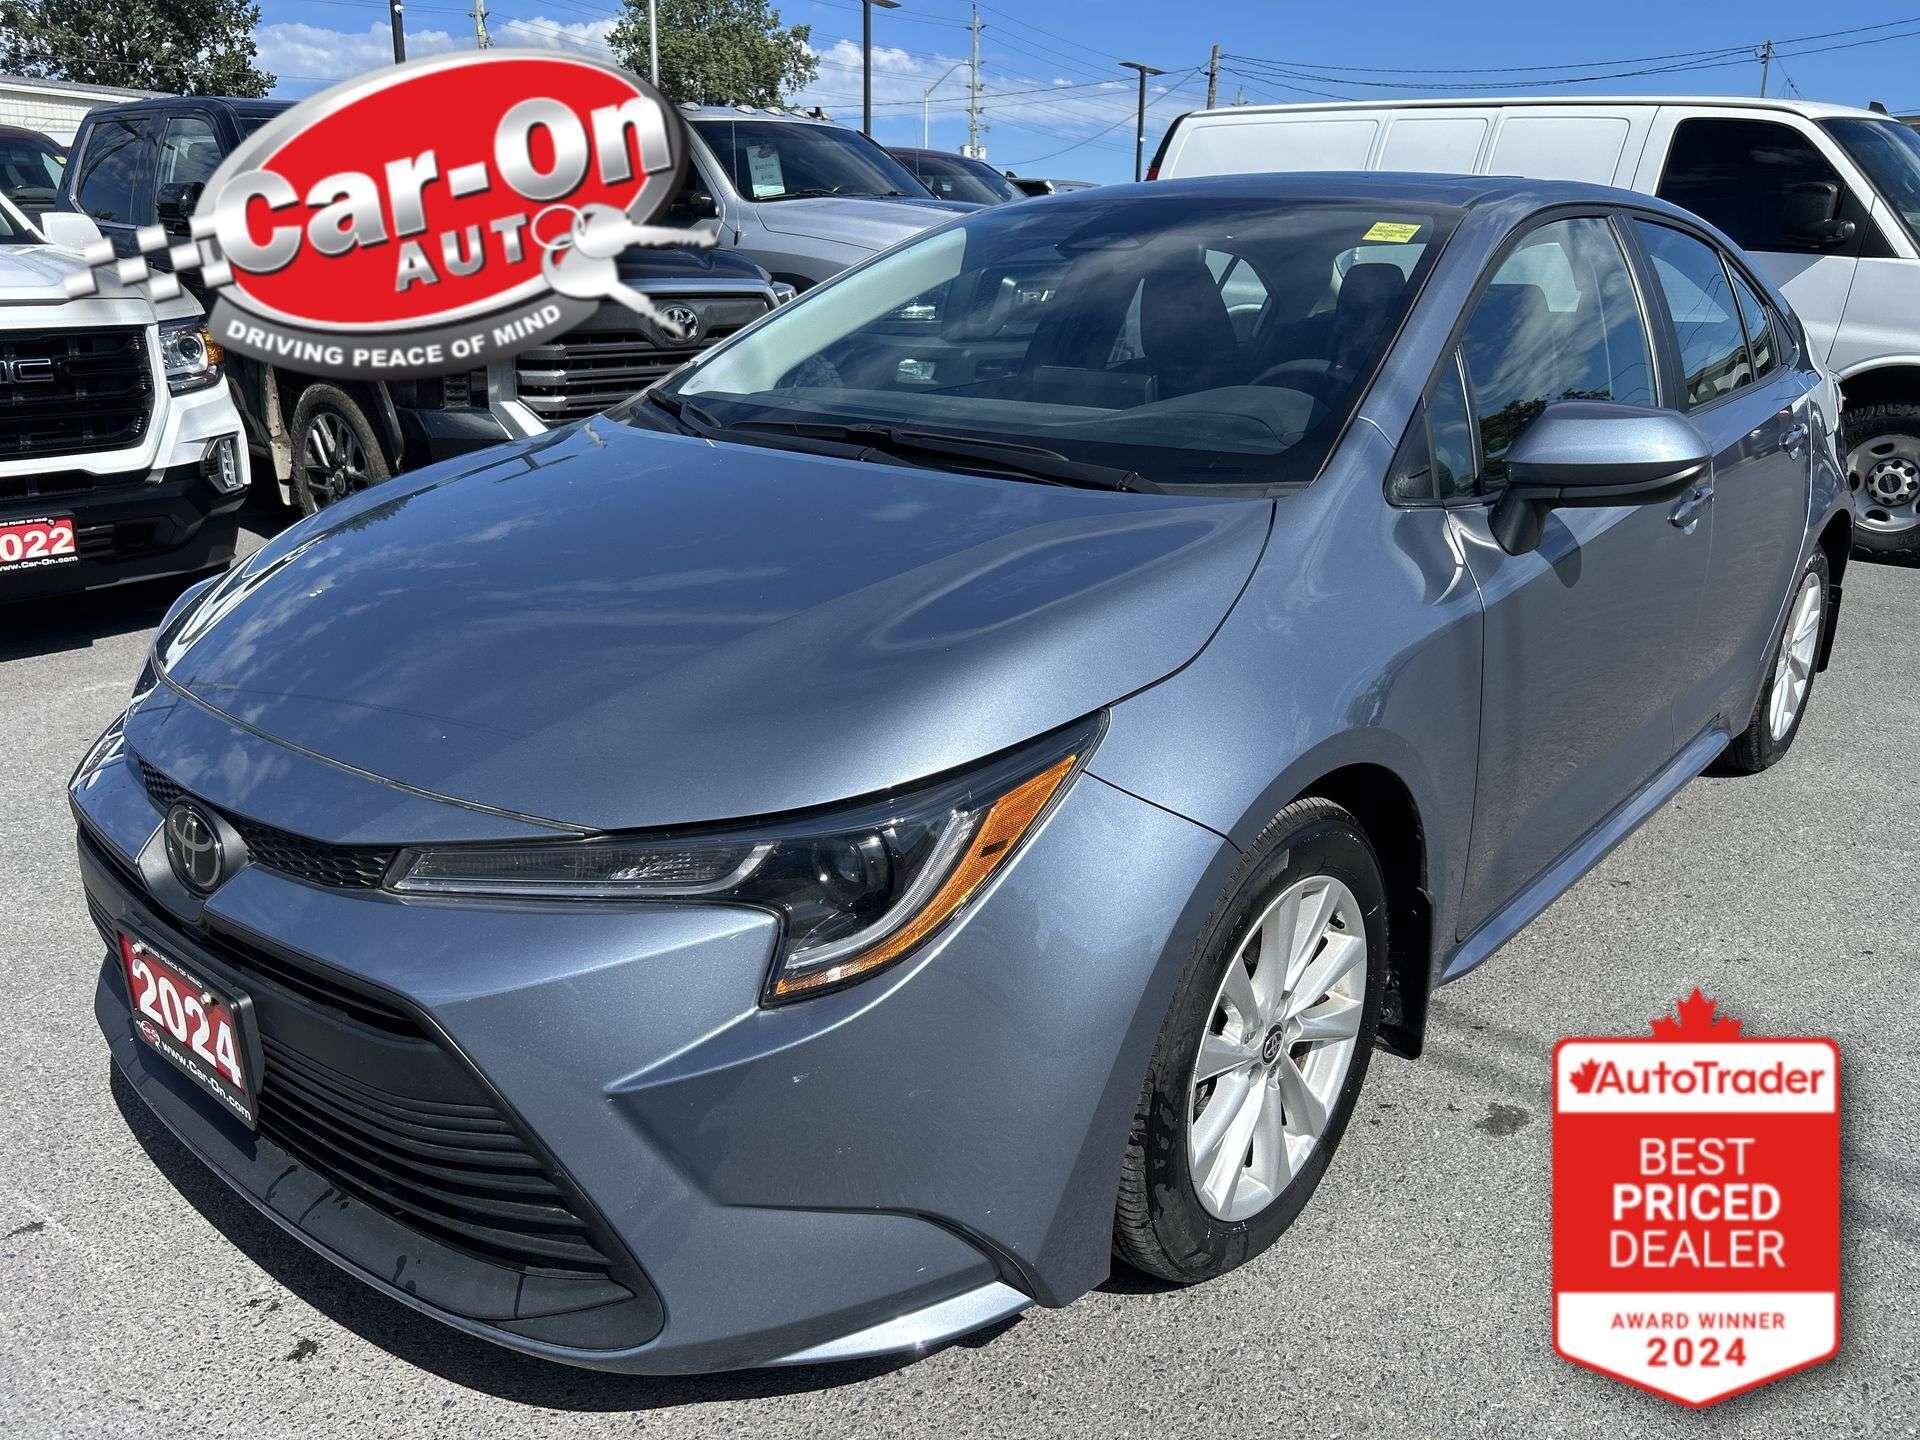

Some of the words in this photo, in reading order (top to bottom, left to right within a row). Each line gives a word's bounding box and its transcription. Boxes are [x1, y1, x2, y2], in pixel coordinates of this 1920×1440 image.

[0, 527, 75, 561] 022
[132, 958, 242, 1089] 2024
[161, 1041, 252, 1121] www.Car-On.com
